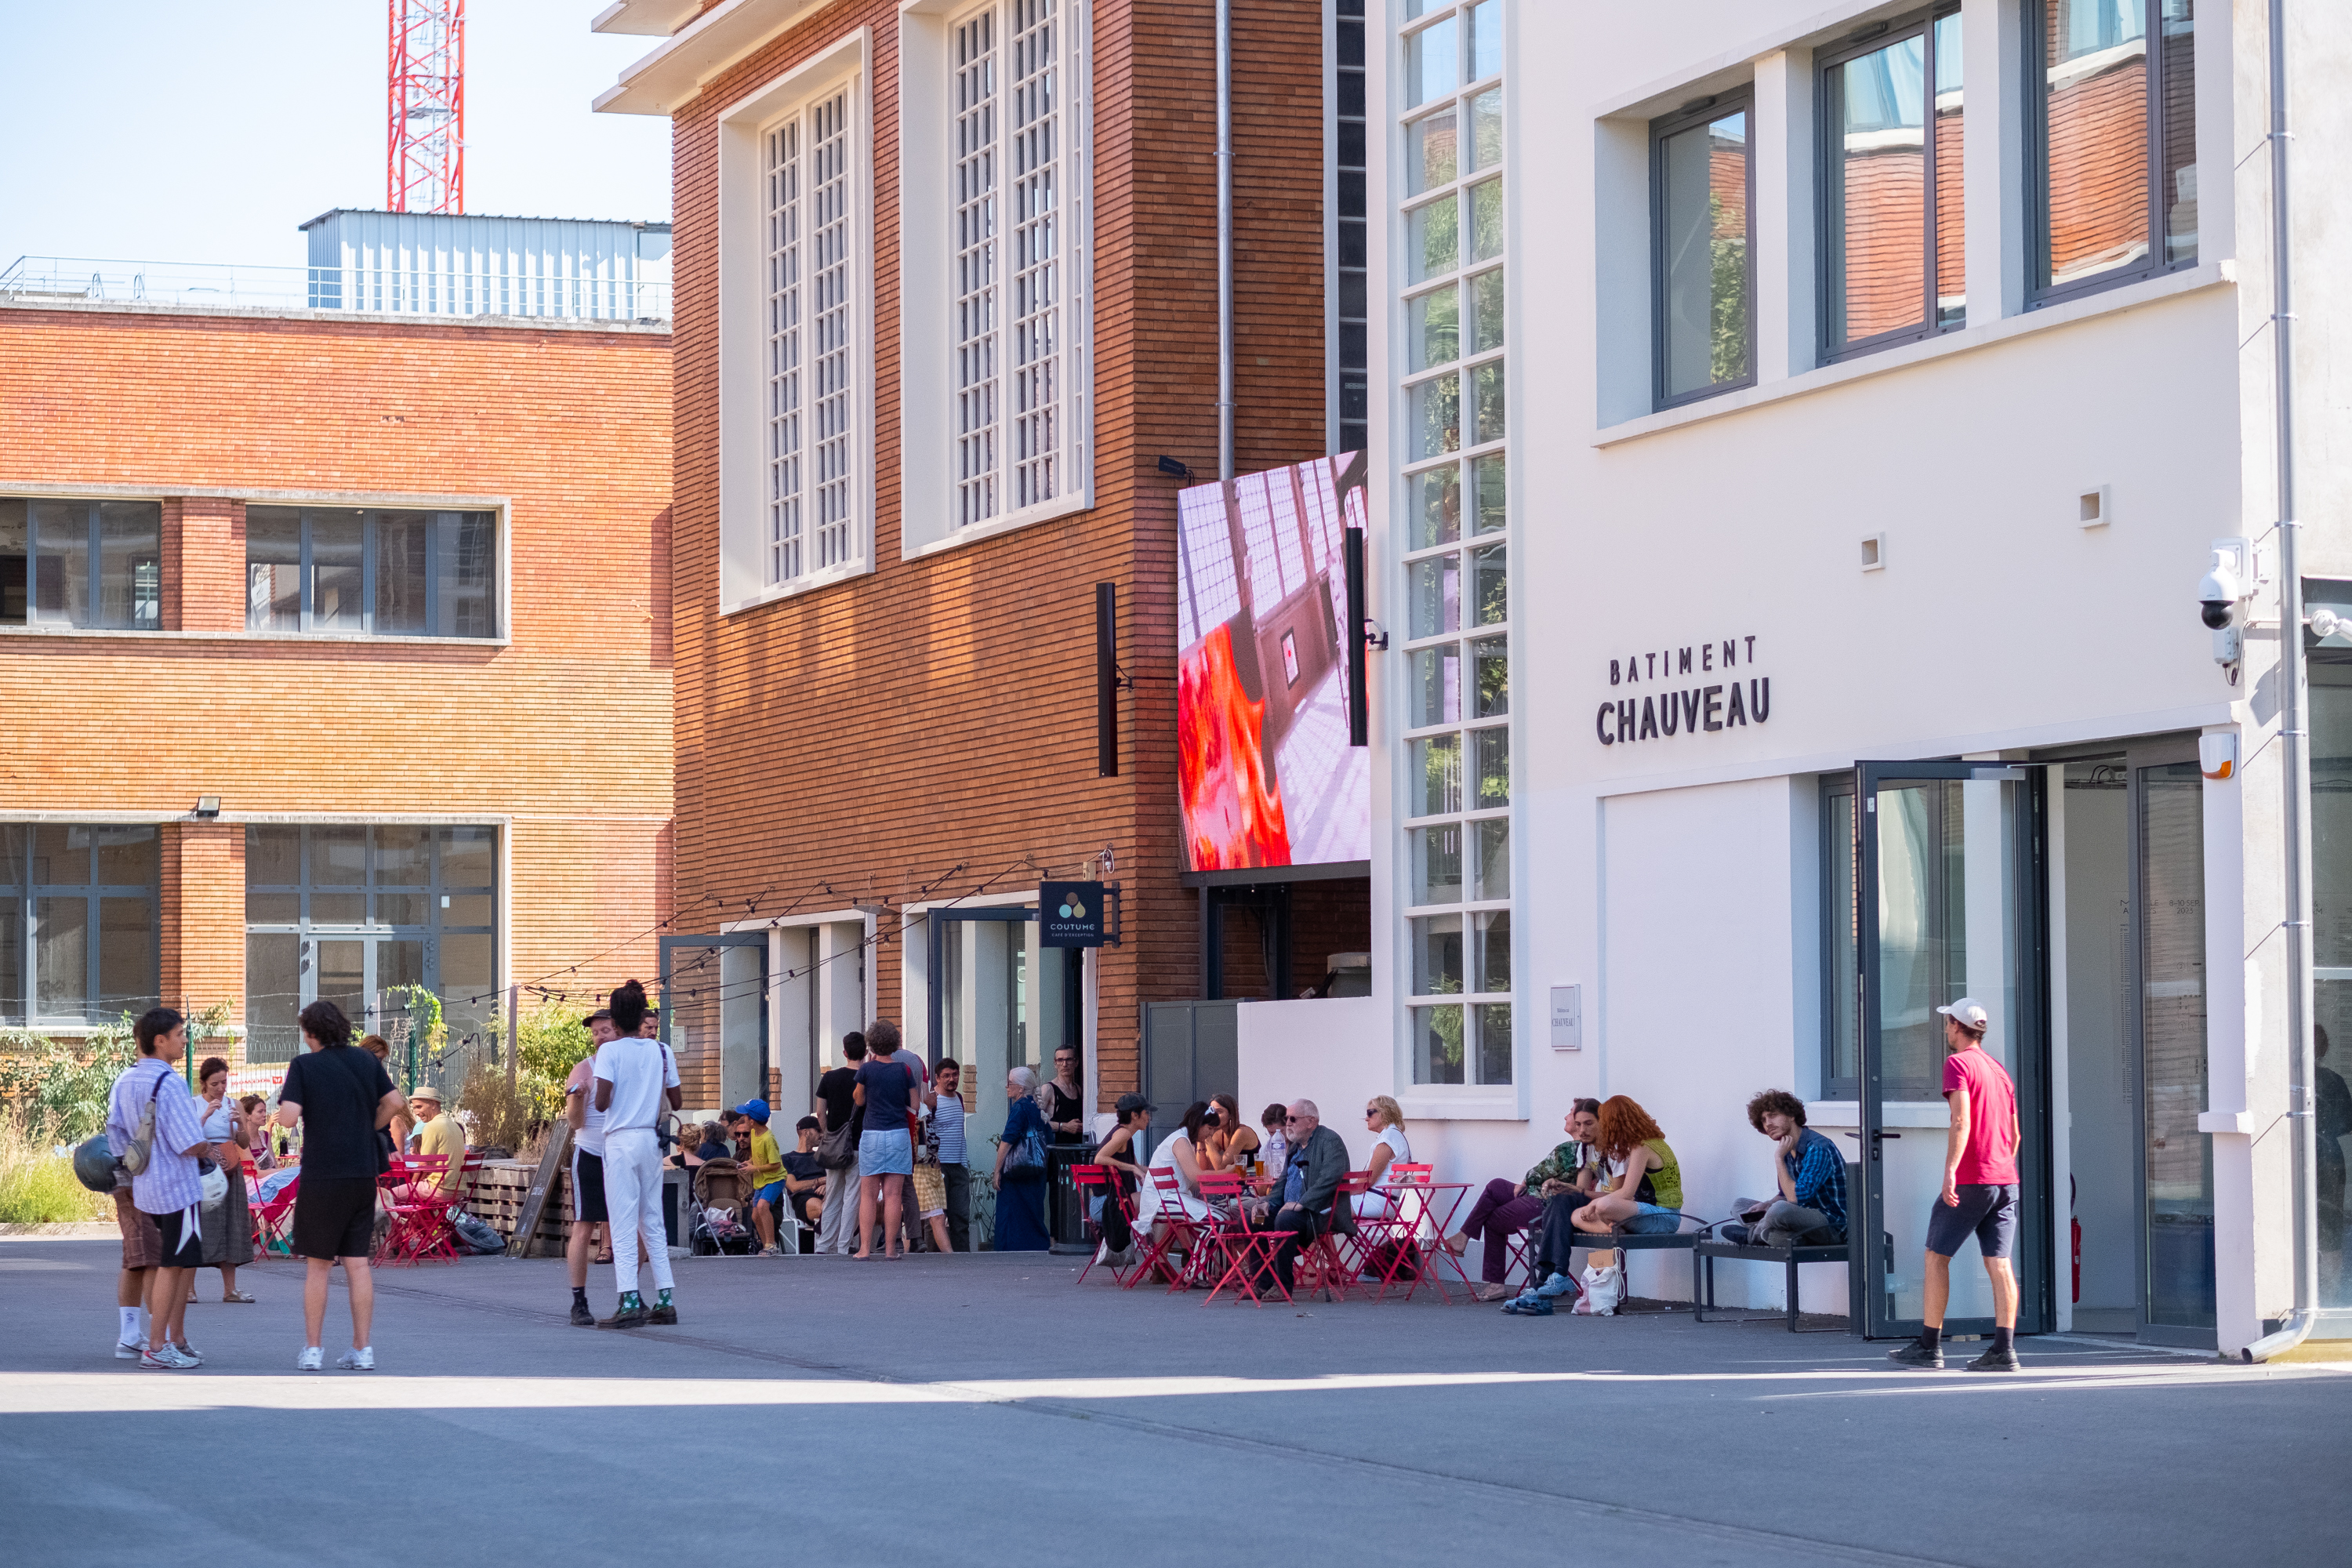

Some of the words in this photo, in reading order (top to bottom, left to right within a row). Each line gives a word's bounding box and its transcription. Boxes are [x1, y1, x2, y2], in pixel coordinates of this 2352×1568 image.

[1610, 635, 1756, 685] BATIMENT
[1596, 677, 1769, 746] CHAUVEAU
[1552, 1018, 1574, 1027] CHAUVEAU
